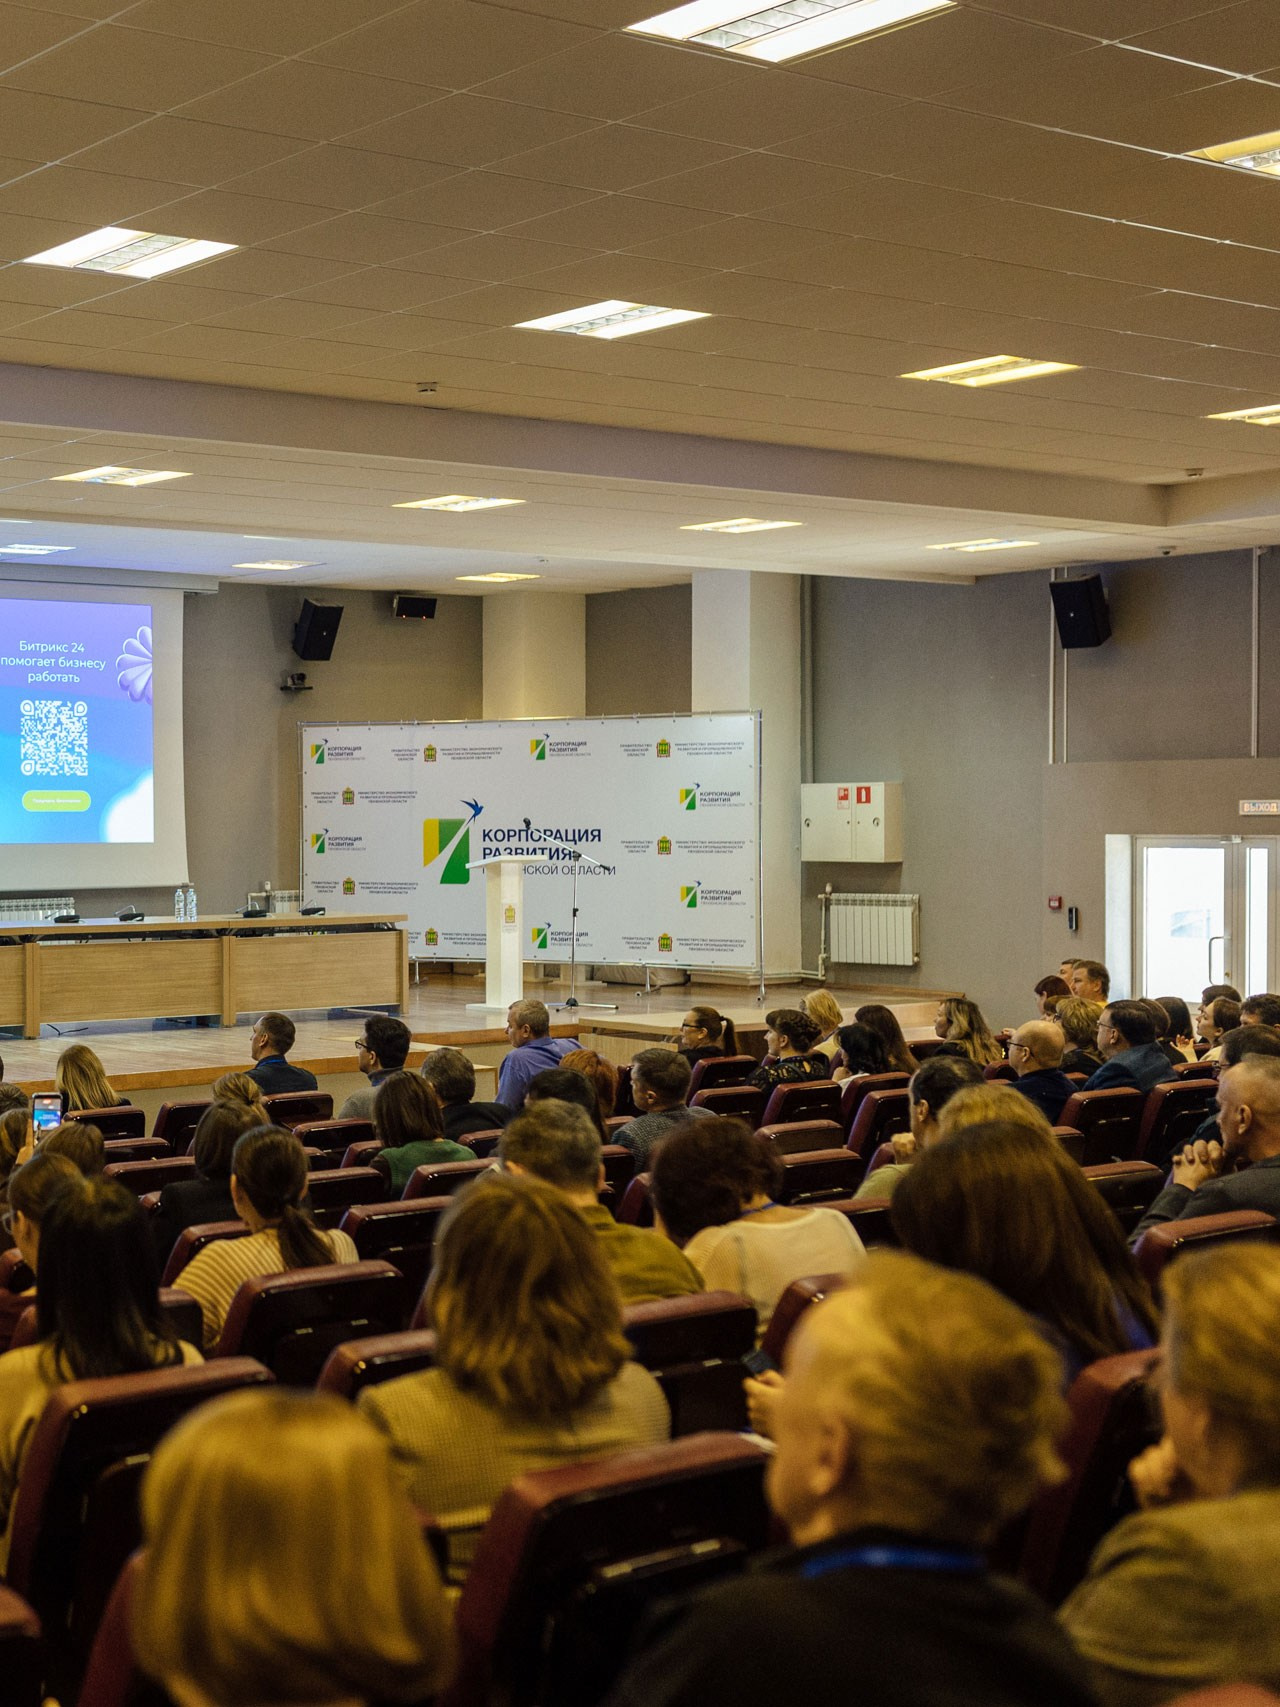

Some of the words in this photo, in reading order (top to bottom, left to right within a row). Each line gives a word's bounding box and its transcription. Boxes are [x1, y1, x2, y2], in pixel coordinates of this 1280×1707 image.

[19, 640, 68, 653] Битрикс
[71, 642, 85, 653] 24
[1, 657, 55, 668] помогает
[58, 656, 106, 671] бизнесу
[27, 671, 80, 684] работать
[1244, 803, 1277, 812] ВЫХОД
[482, 828, 601, 845] КОРПОРАЦИЯ
[482, 847, 572, 860] РАЗВИТИЯ
